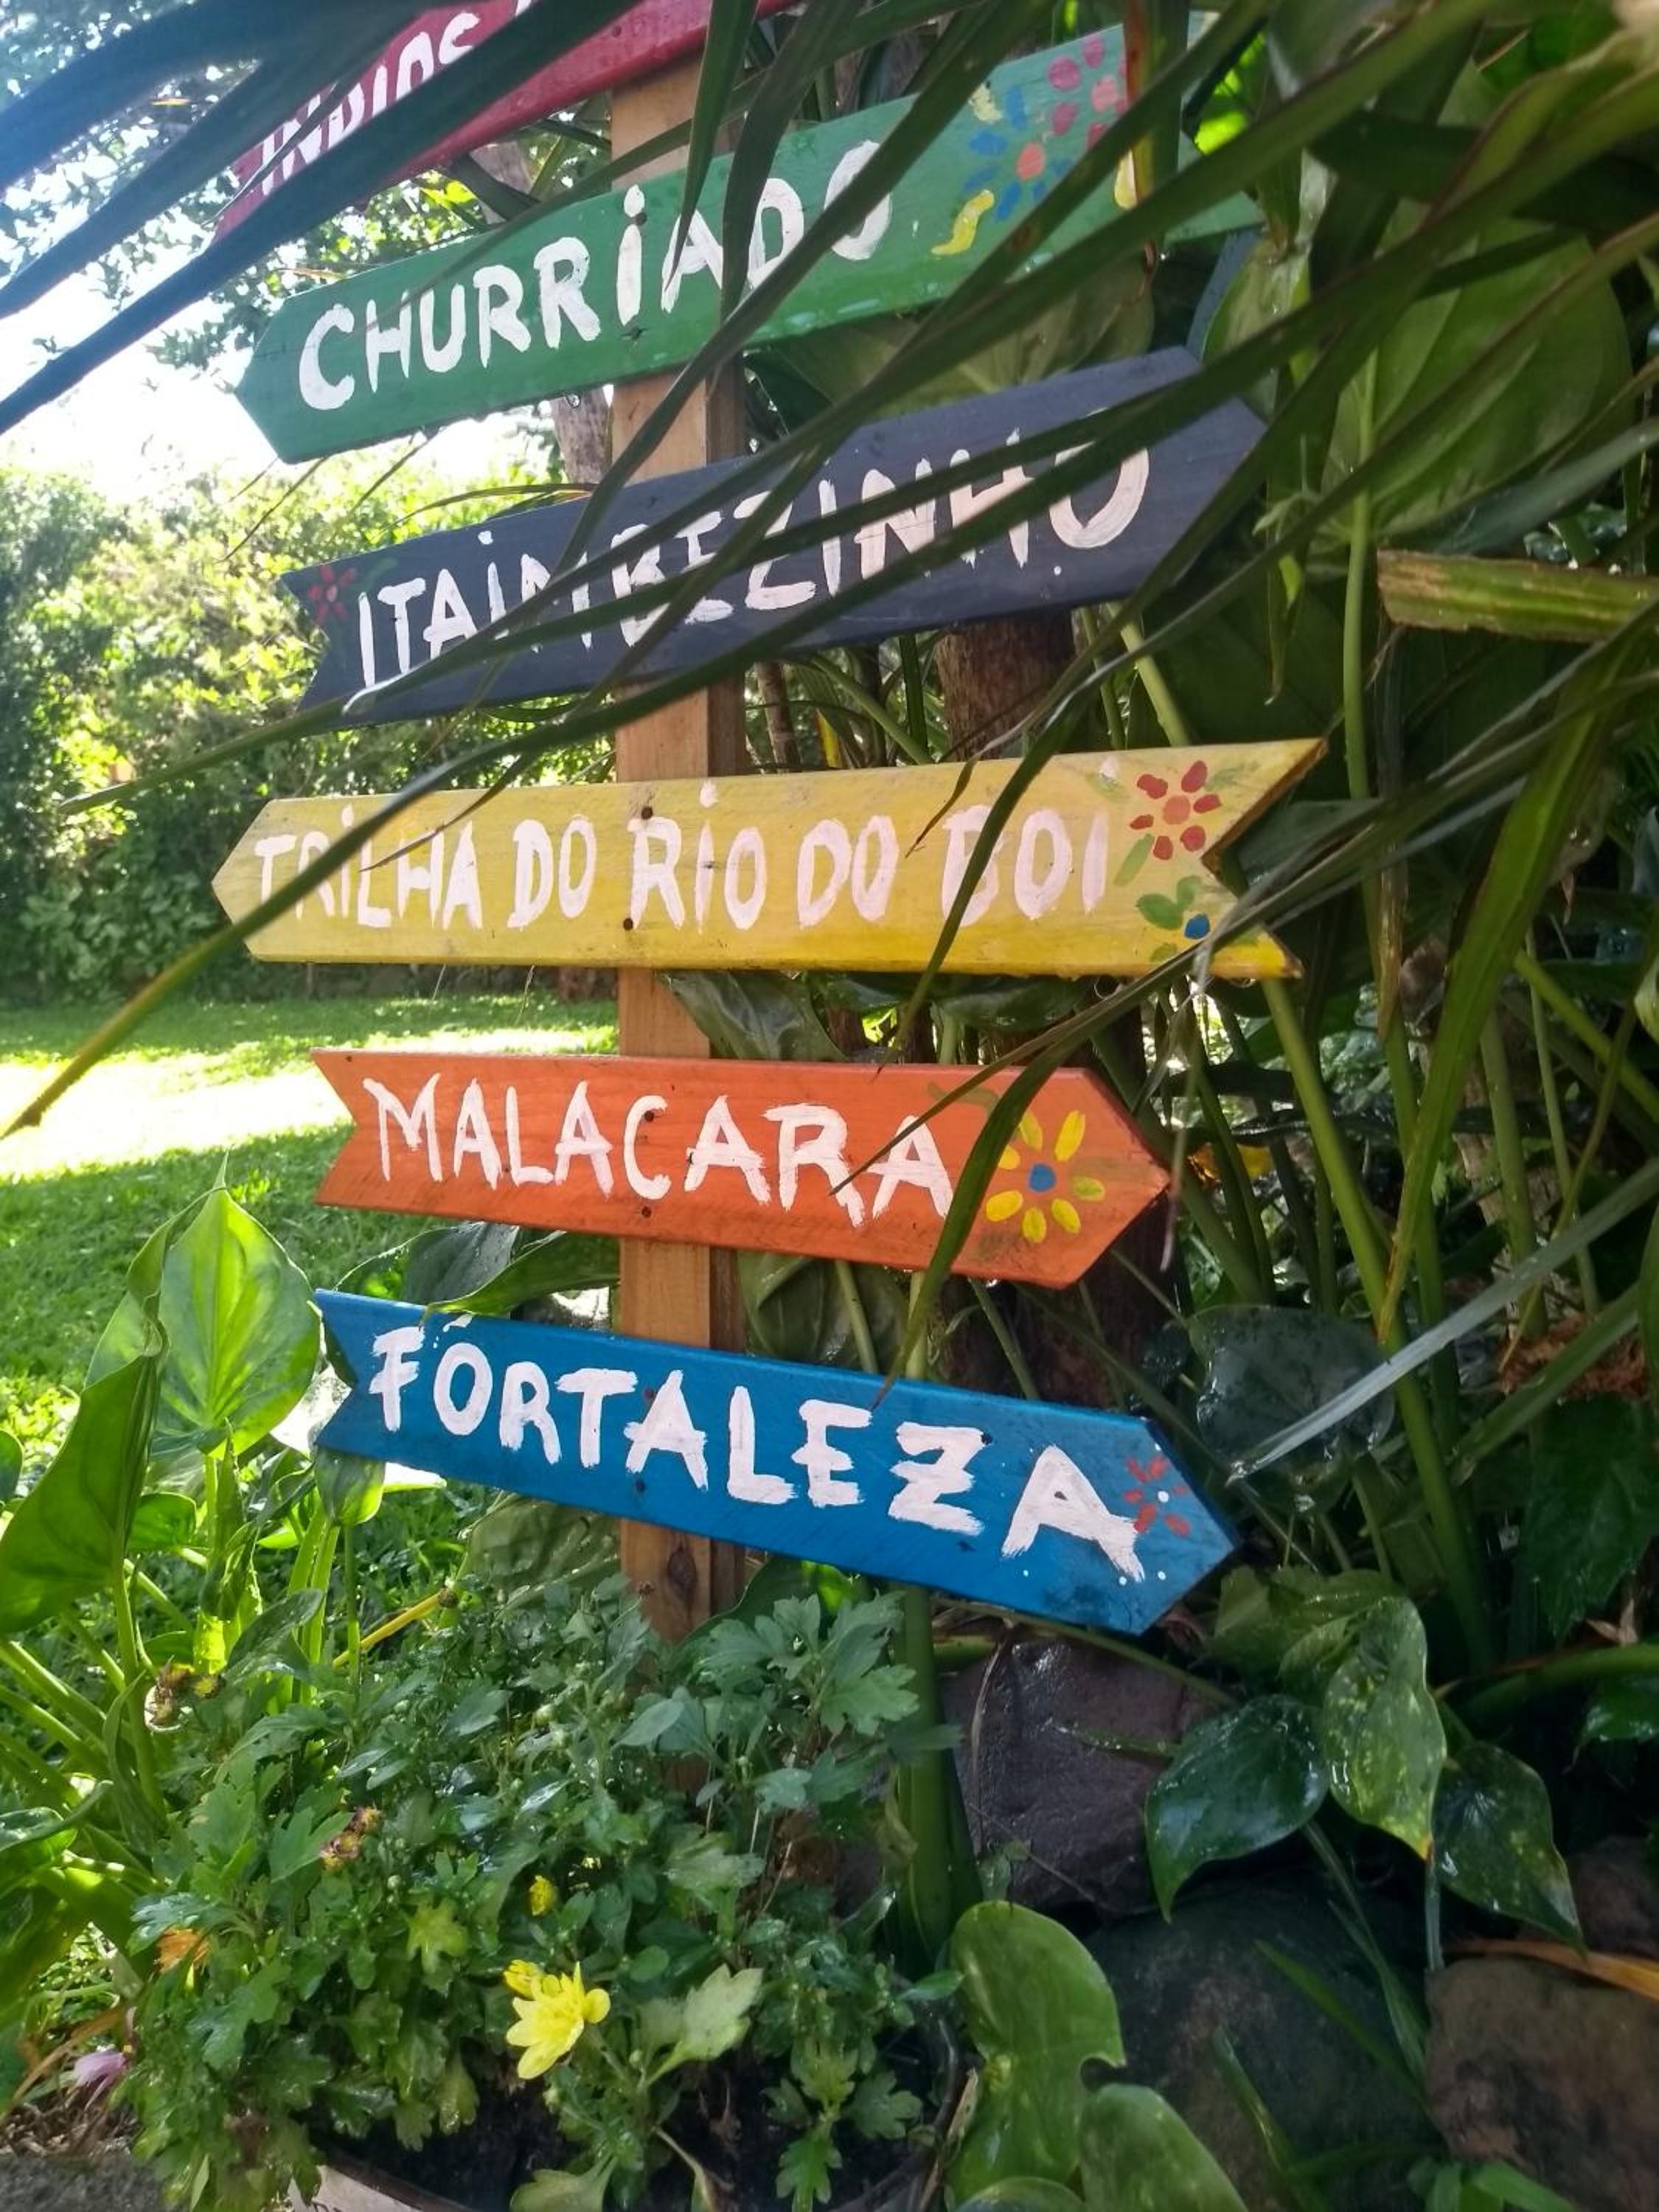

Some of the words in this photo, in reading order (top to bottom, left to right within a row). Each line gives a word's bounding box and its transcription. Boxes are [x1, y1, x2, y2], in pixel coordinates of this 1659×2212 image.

[507, 814, 597, 931] DO
[797, 815, 900, 930] DO
[942, 804, 1107, 928] BOI
[362, 1072, 953, 1228] MALACARA
